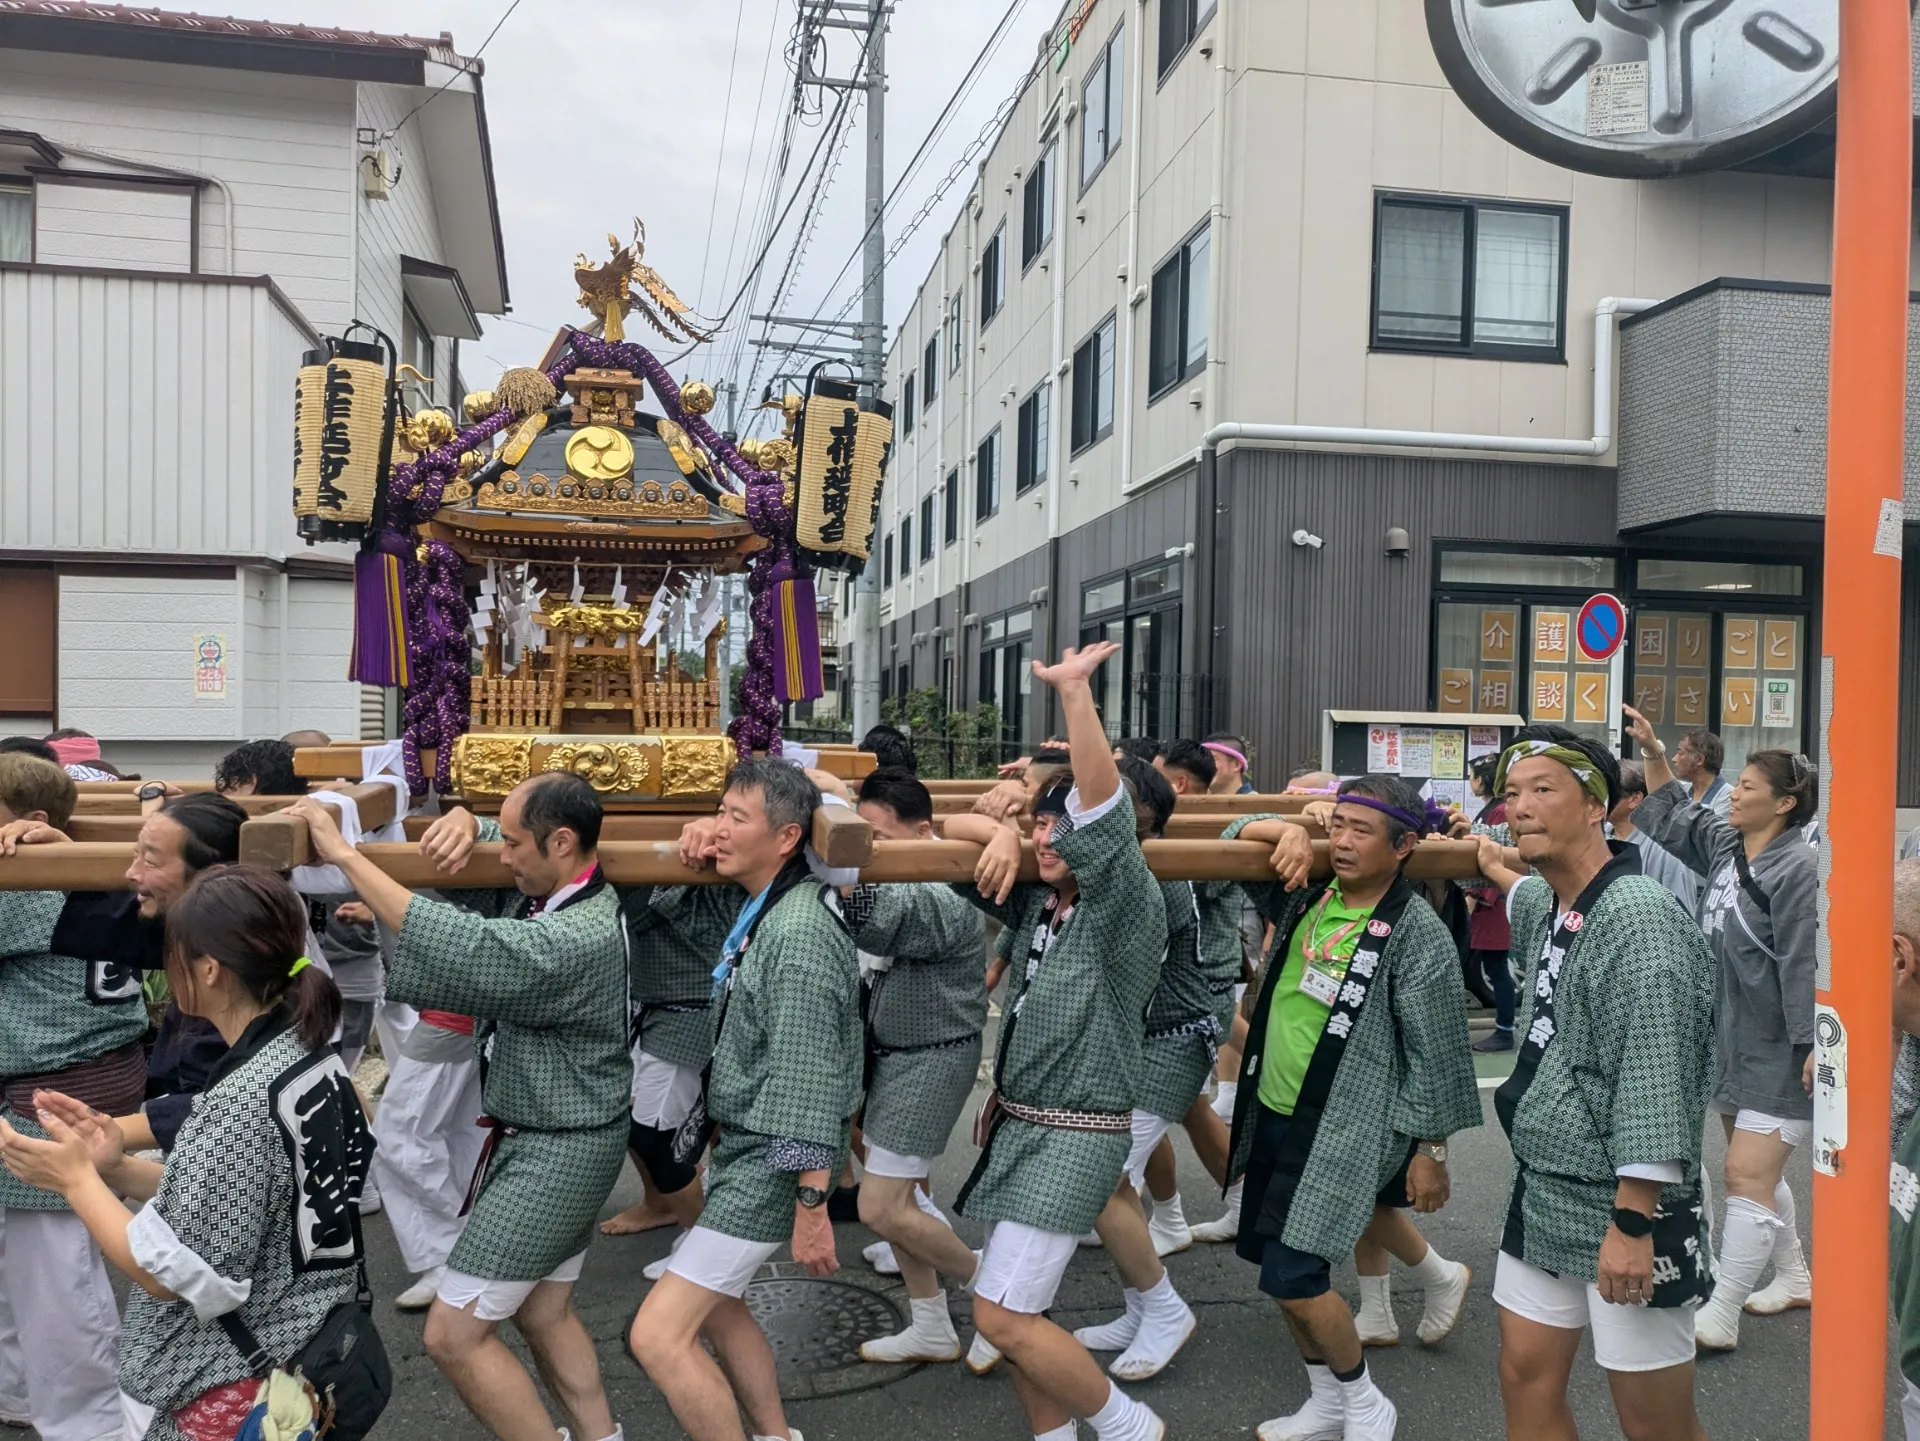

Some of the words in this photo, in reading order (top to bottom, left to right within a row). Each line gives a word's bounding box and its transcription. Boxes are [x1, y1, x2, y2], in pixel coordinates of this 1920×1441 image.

[1444, 677, 1751, 713] ご相談ください
[1817, 1063, 1836, 1088] 高
